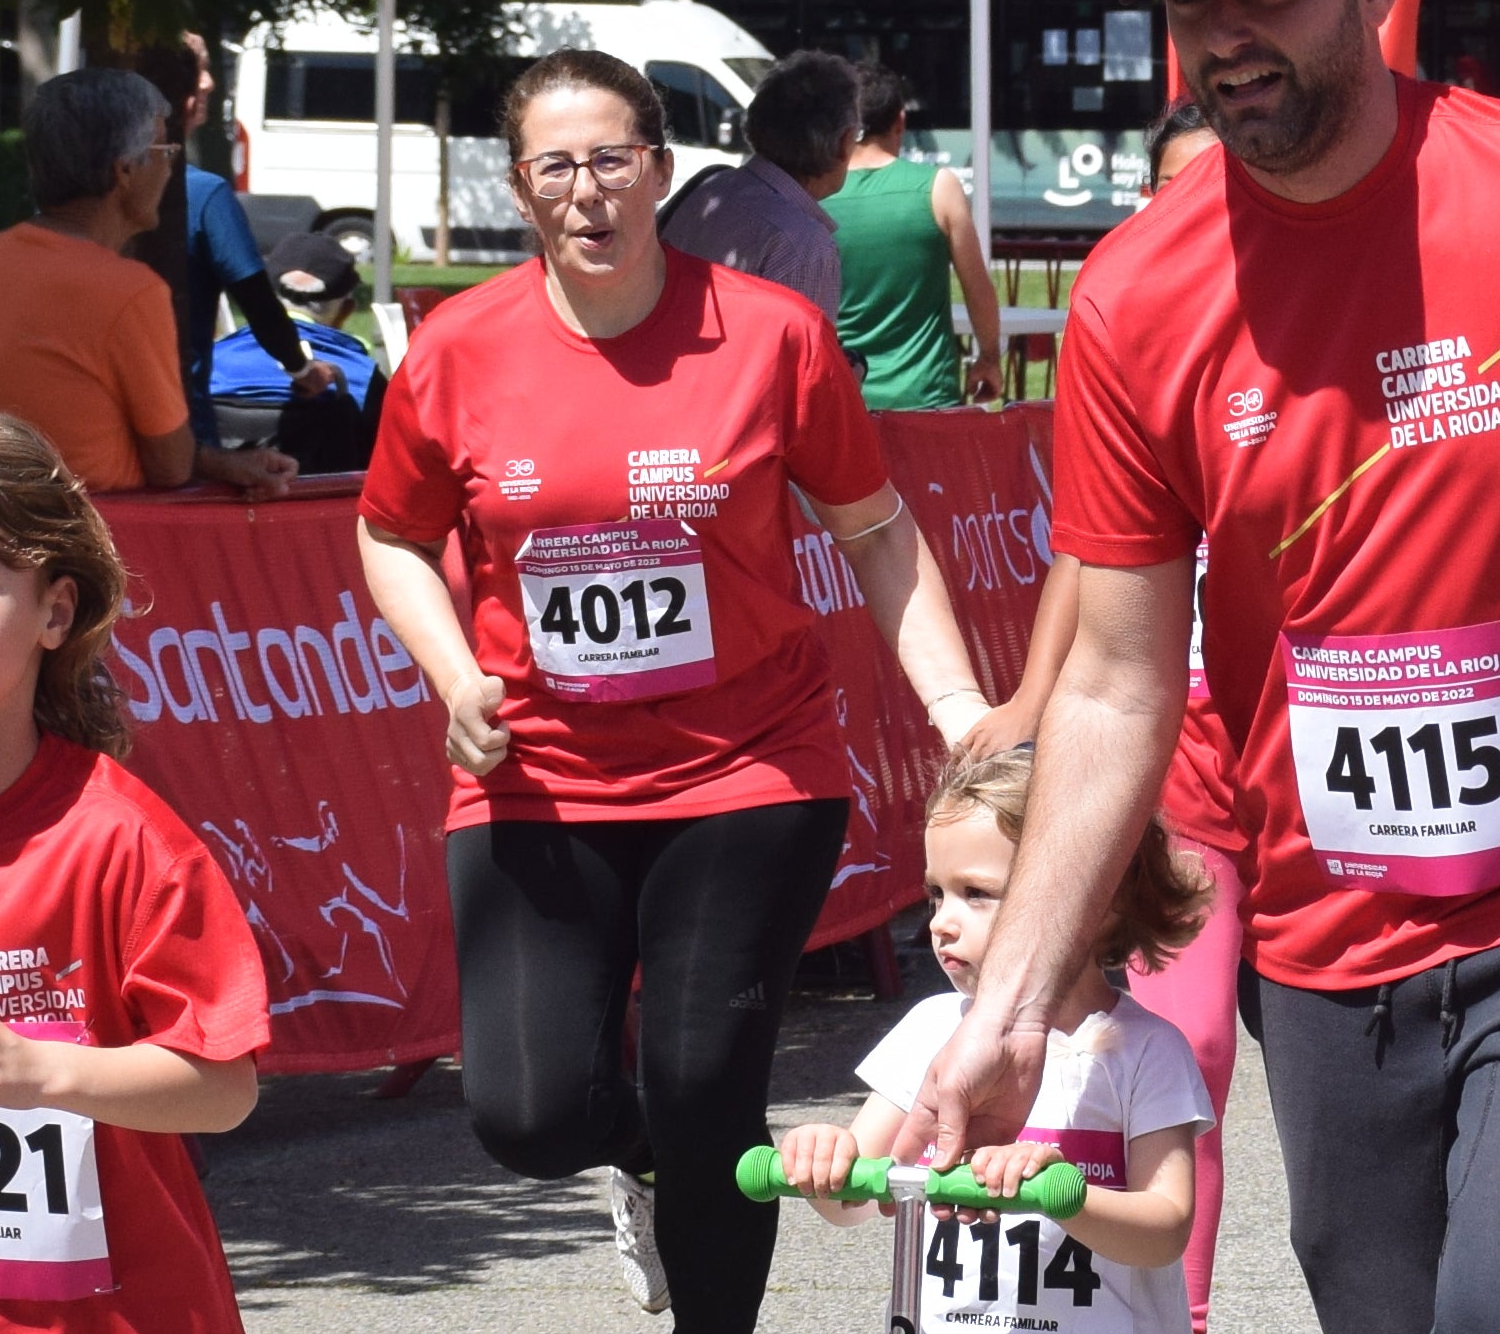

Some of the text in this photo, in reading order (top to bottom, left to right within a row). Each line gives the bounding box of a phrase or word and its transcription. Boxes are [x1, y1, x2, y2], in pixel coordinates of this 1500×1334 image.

[1376, 337, 1471, 374] CARRERA
[1382, 362, 1466, 398] CAMPUS
[1391, 424, 1417, 448] DE
[1420, 419, 1447, 443] LA
[628, 449, 700, 467] CARRERA
[628, 467, 695, 484] CAMPUS
[629, 484, 730, 503] UNIVERSIDAD
[630, 501, 718, 520] DE LA RIOJA
[531, 530, 639, 548] ARRERA CAMPUS
[612, 542, 630, 553] DE
[632, 540, 650, 551] LA
[652, 538, 689, 551] RIOJA
[526, 565, 568, 575] DOMINGO
[580, 563, 595, 572] DE
[622, 560, 637, 569] DE
[638, 557, 661, 566] 2022
[540, 577, 692, 645] 4012
[111, 589, 427, 722] Santande
[578, 647, 660, 663] CARRERA FAMILIAR
[1292, 645, 1441, 664] CARRERA CAMPUS
[1295, 663, 1402, 681] UNIVERSIDAD
[1406, 663, 1431, 678] DE
[1434, 661, 1458, 676] LA
[1297, 688, 1475, 706] DOMINGO 15 DE MAYO DE 2022
[1369, 820, 1477, 837] CARRERA FAMILIAR
[1076, 1162, 1115, 1181] RIOJA
[926, 1217, 1101, 1307] 4114
[946, 1312, 1059, 1332] CARRERA FAMILIAR
